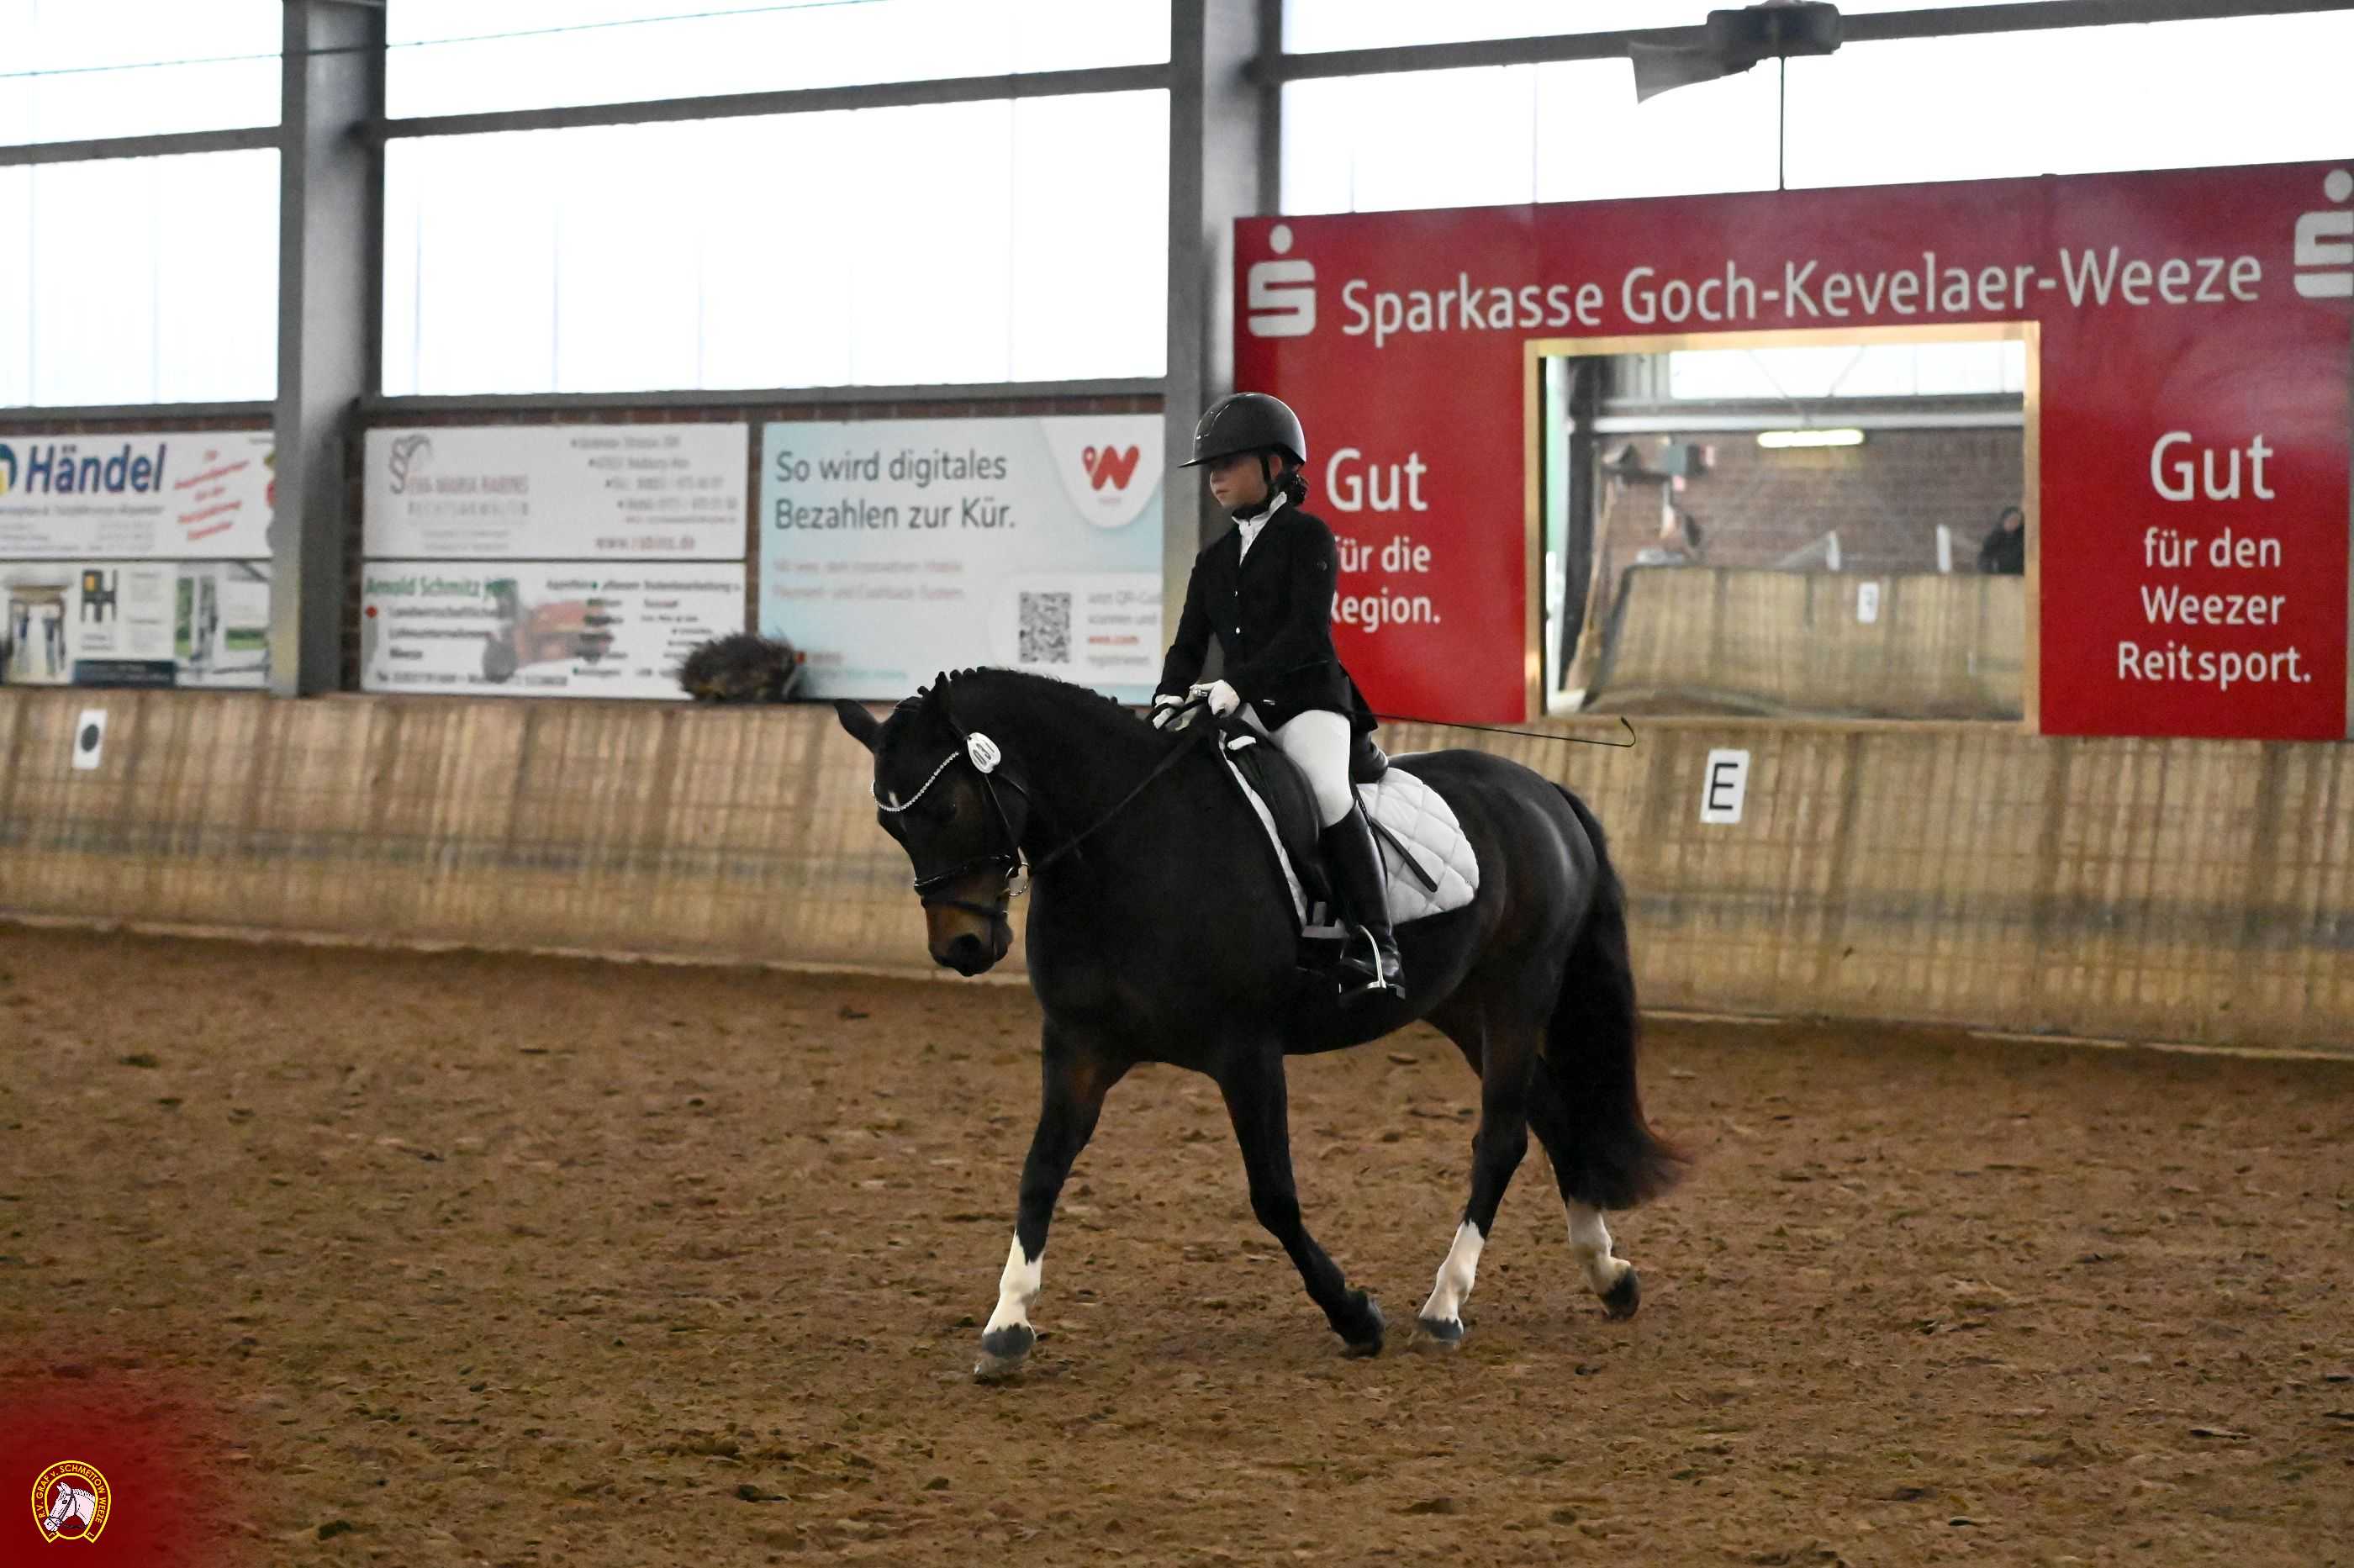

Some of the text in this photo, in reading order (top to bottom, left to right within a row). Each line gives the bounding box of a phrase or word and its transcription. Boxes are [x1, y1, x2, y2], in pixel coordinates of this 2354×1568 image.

[1342, 245, 2262, 348] Sparkasse Goch-Kevelaer-Weeze
[26, 443, 166, 494] Händel
[776, 448, 1007, 488] So wird digitales
[1325, 447, 1429, 512] Gut
[2150, 430, 2276, 502] Gut
[774, 496, 1016, 530] Bezahlen zur Kür.
[1333, 535, 1431, 573] ür die
[2144, 525, 2282, 568] für den
[2140, 584, 2286, 626] Weezer
[2117, 639, 2311, 692] Reitsport.
[1708, 763, 1739, 810] E
